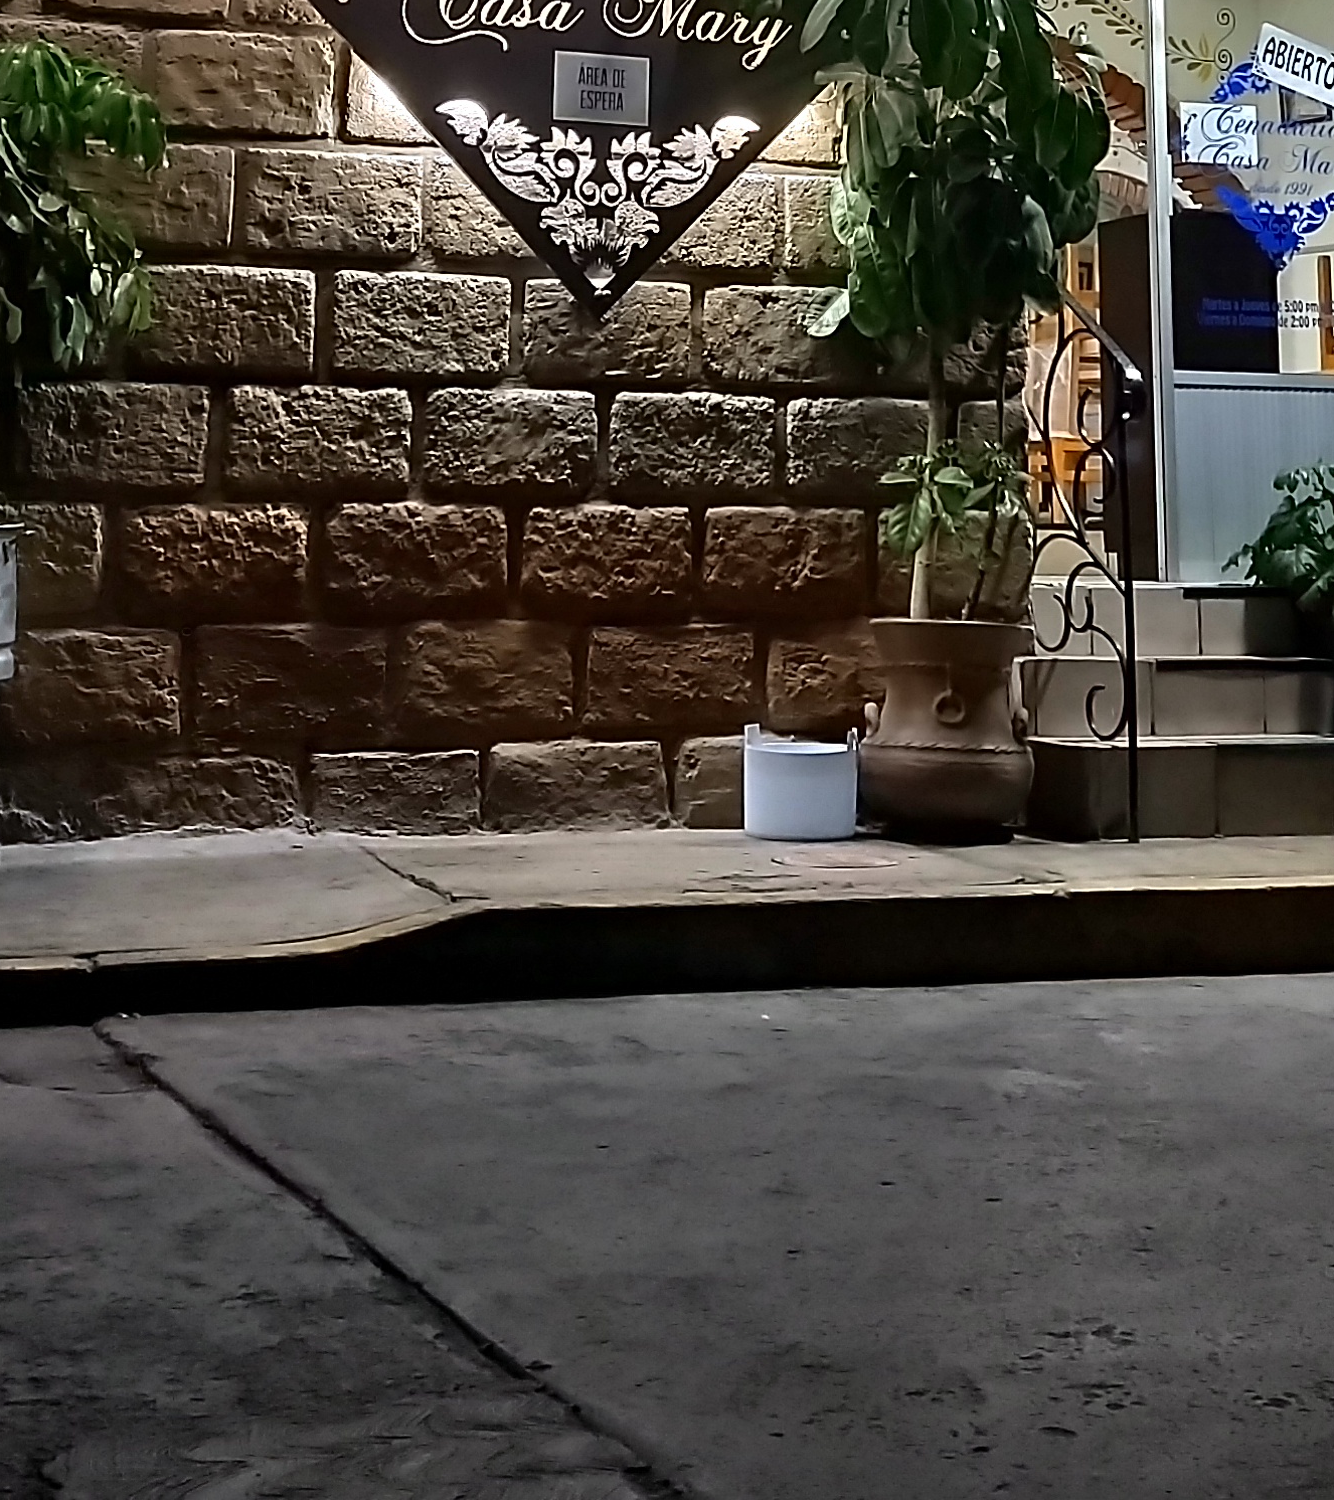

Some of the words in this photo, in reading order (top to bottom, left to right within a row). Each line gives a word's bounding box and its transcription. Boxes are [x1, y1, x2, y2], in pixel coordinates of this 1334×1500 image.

[578, 62, 608, 87] ÁREA
[612, 68, 626, 88] DE
[580, 90, 624, 111] ESPERA
[1198, 143, 1270, 176] Casa
[1284, 182, 1314, 197] 1991
[1284, 300, 1303, 313] 5:00
[1290, 315, 1310, 328] 2:00
